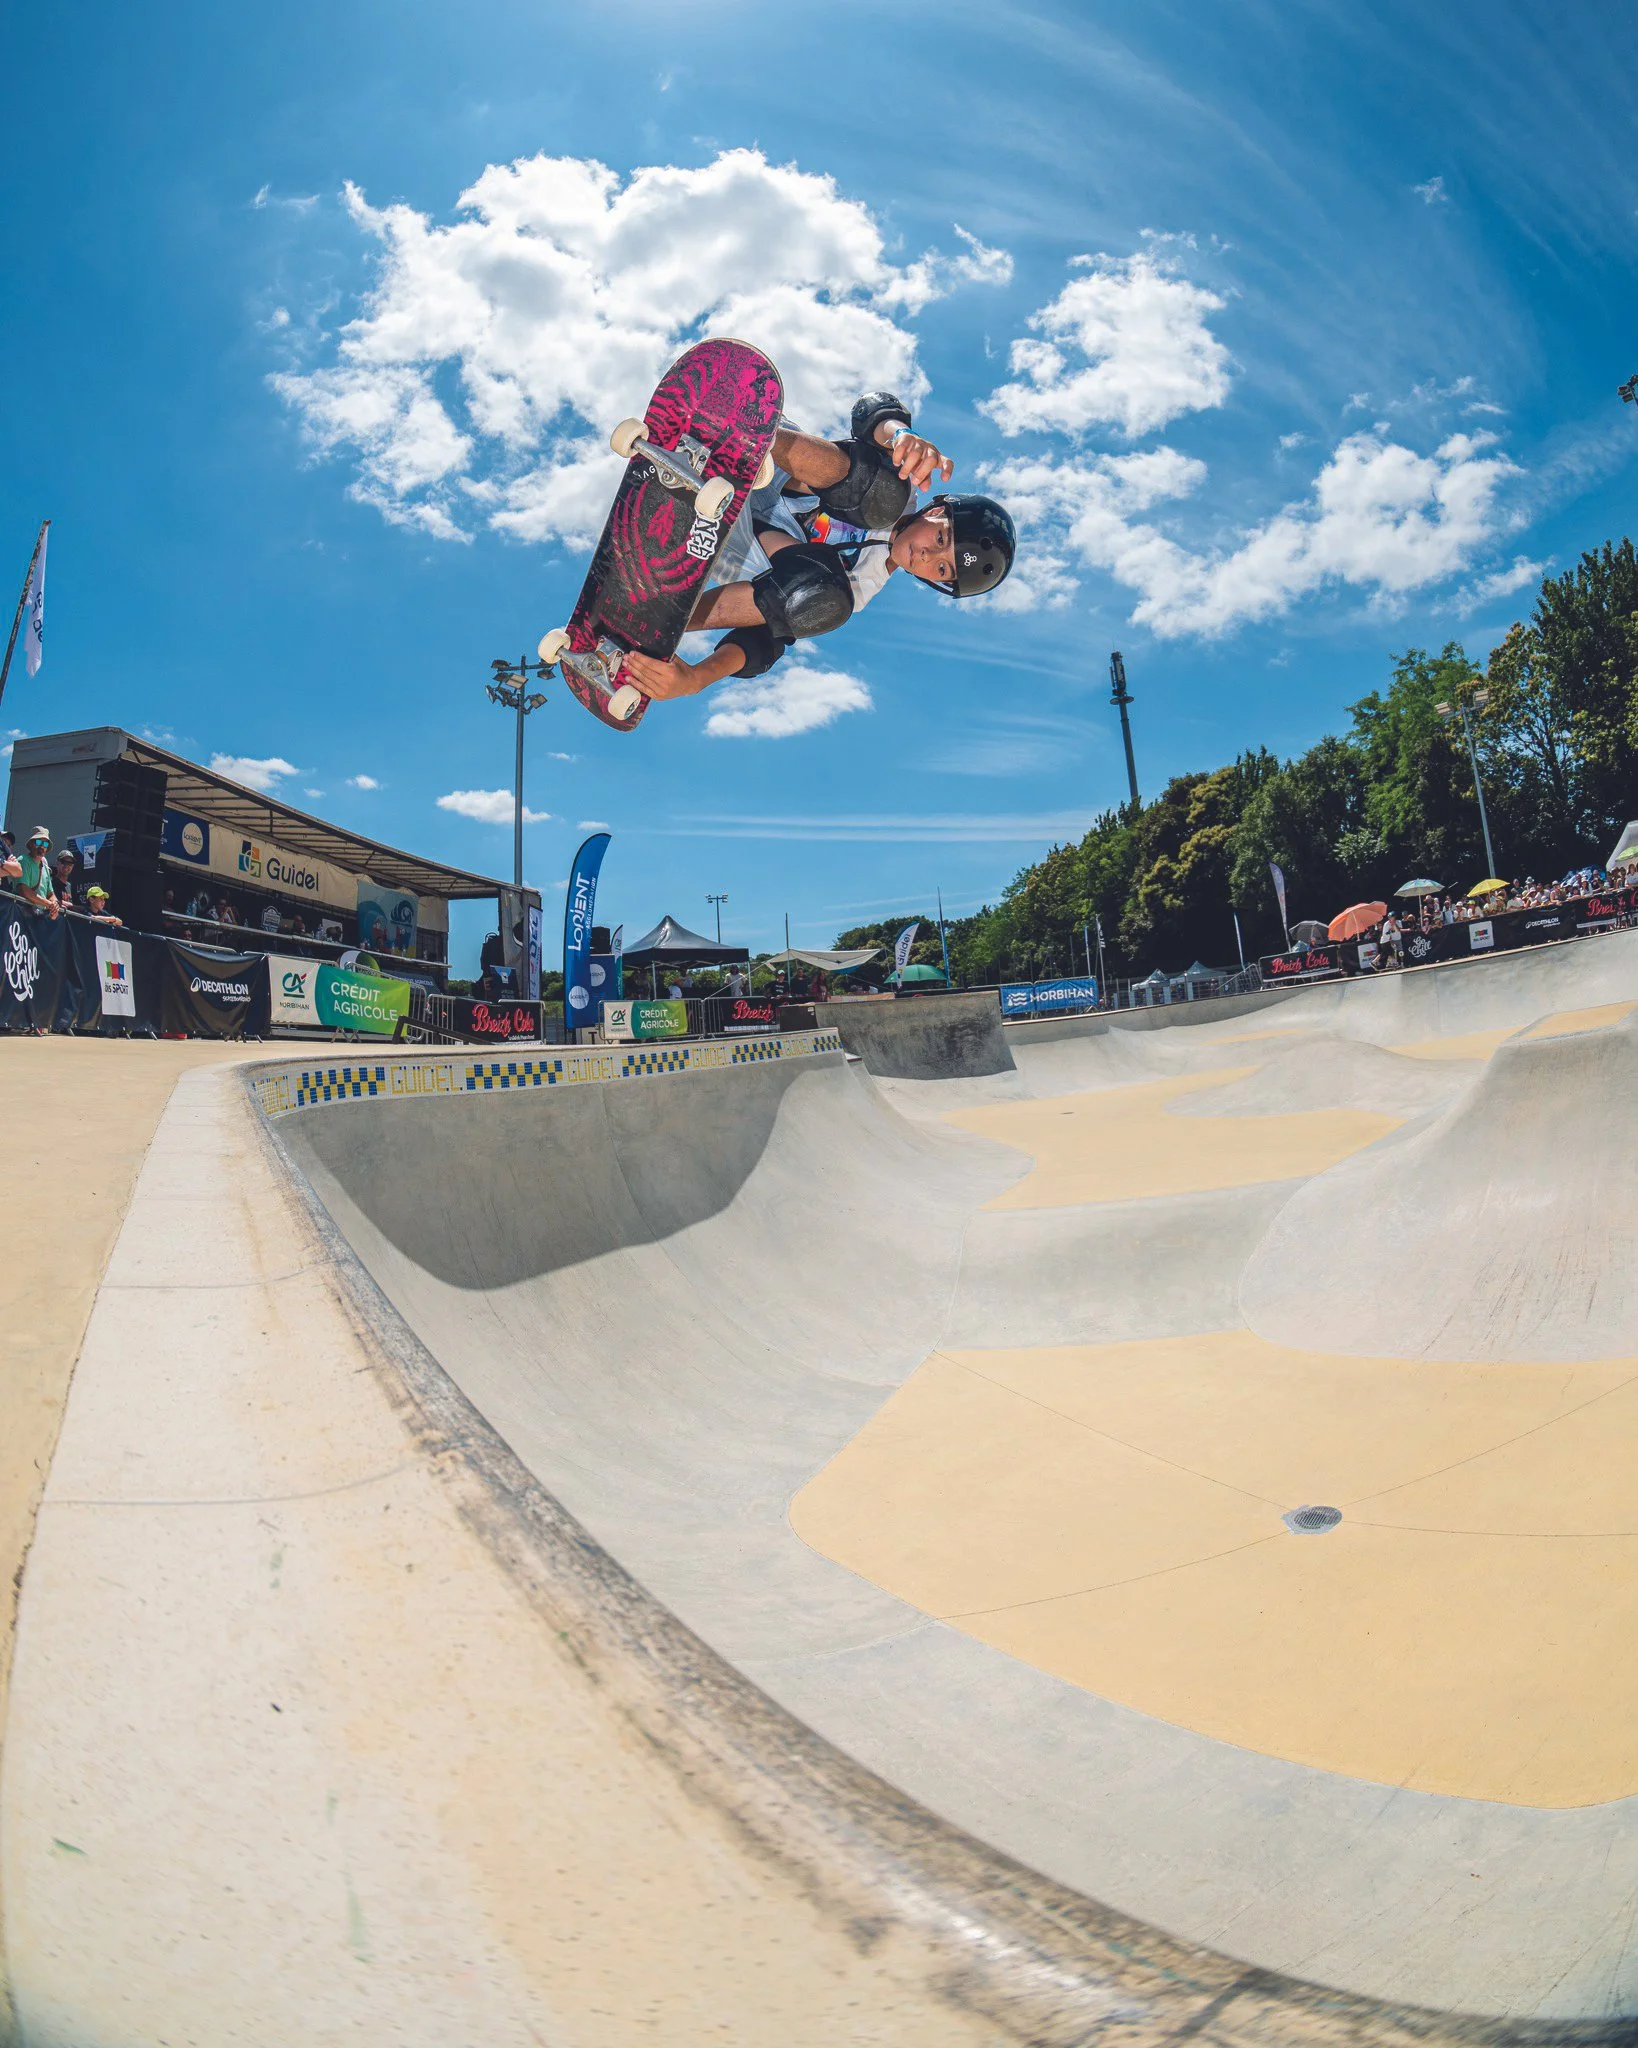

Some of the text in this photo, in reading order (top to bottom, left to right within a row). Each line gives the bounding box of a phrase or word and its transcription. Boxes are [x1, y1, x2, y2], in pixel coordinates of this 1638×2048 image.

[266, 857, 319, 892] Guidel
[567, 872, 590, 952] LORIENT
[9, 921, 28, 965] Go
[4, 946, 40, 1002] Chill
[1271, 957, 1302, 974] Breizh
[1306, 952, 1330, 969] Cola
[202, 980, 249, 994] DECATHLON
[330, 981, 381, 1002] CRÉDIT
[1029, 987, 1094, 1003] MORBIHAN
[333, 1000, 398, 1021] AGRICOLE
[471, 1003, 534, 1038] Breizh Cola
[640, 1008, 668, 1018] CRÉDIT
[732, 999, 775, 1022] Breizh
[640, 1019, 679, 1029] AGRICOLE
[691, 1046, 732, 1069] GUIDEL
[390, 1065, 463, 1095] GUIDEL
[565, 1056, 621, 1083] GUIDEL
